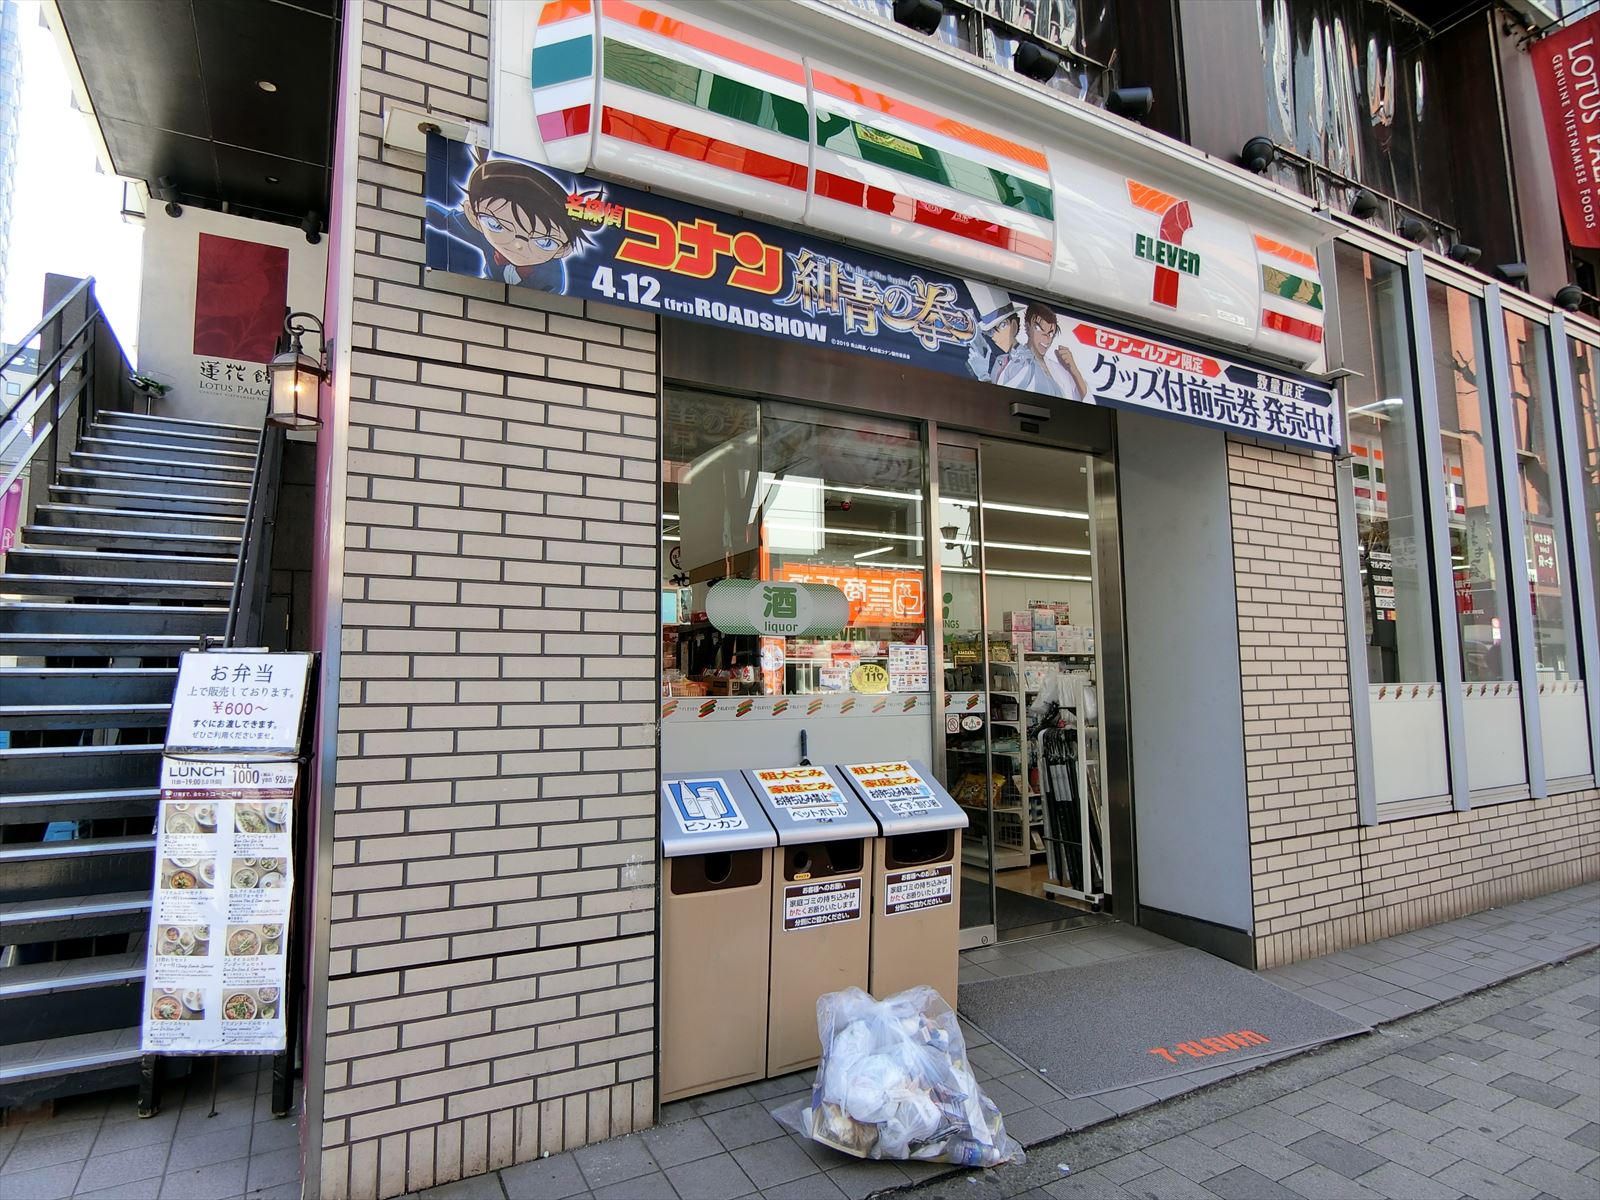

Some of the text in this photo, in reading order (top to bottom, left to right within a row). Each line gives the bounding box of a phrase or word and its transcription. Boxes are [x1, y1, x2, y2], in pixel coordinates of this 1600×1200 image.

[1567, 37, 1600, 124] LOTUS
[1552, 54, 1596, 228] GENUINE VIETNAMESE FOODS
[564, 193, 625, 229] 名探偵
[615, 207, 783, 294] コナン
[591, 265, 661, 309] 4.12
[694, 297, 828, 343] ROADSHOW
[200, 380, 270, 397] LOTUS PALAC
[1256, 373, 1306, 400] 数量限定
[763, 586, 798, 619] 酒
[764, 621, 799, 633] liquor
[210, 664, 274, 683] お弁当
[862, 665, 880, 673] 子ども
[187, 686, 294, 699] 上で販売しております。
[192, 719, 278, 730] すぐにお渡しできます。
[192, 731, 275, 741] ぜひご利用くださいませ。
[169, 766, 225, 777] LUNCH
[233, 769, 260, 784] 1000
[759, 768, 825, 781] 粗大ごみ
[851, 763, 909, 776] 粗大ごみ
[767, 782, 835, 795] 家庭ごみ
[861, 775, 921, 788] 家庭ごみ
[869, 785, 921, 800] お持ち込み禁止
[774, 793, 832, 807] お持ち込み禁止
[791, 805, 848, 818] ペットボトル
[684, 818, 743, 832] ビン・カン
[890, 878, 948, 894] 家庭ゴミの持ち込みは
[789, 891, 856, 908] 家庭ゴミの持ち込みは
